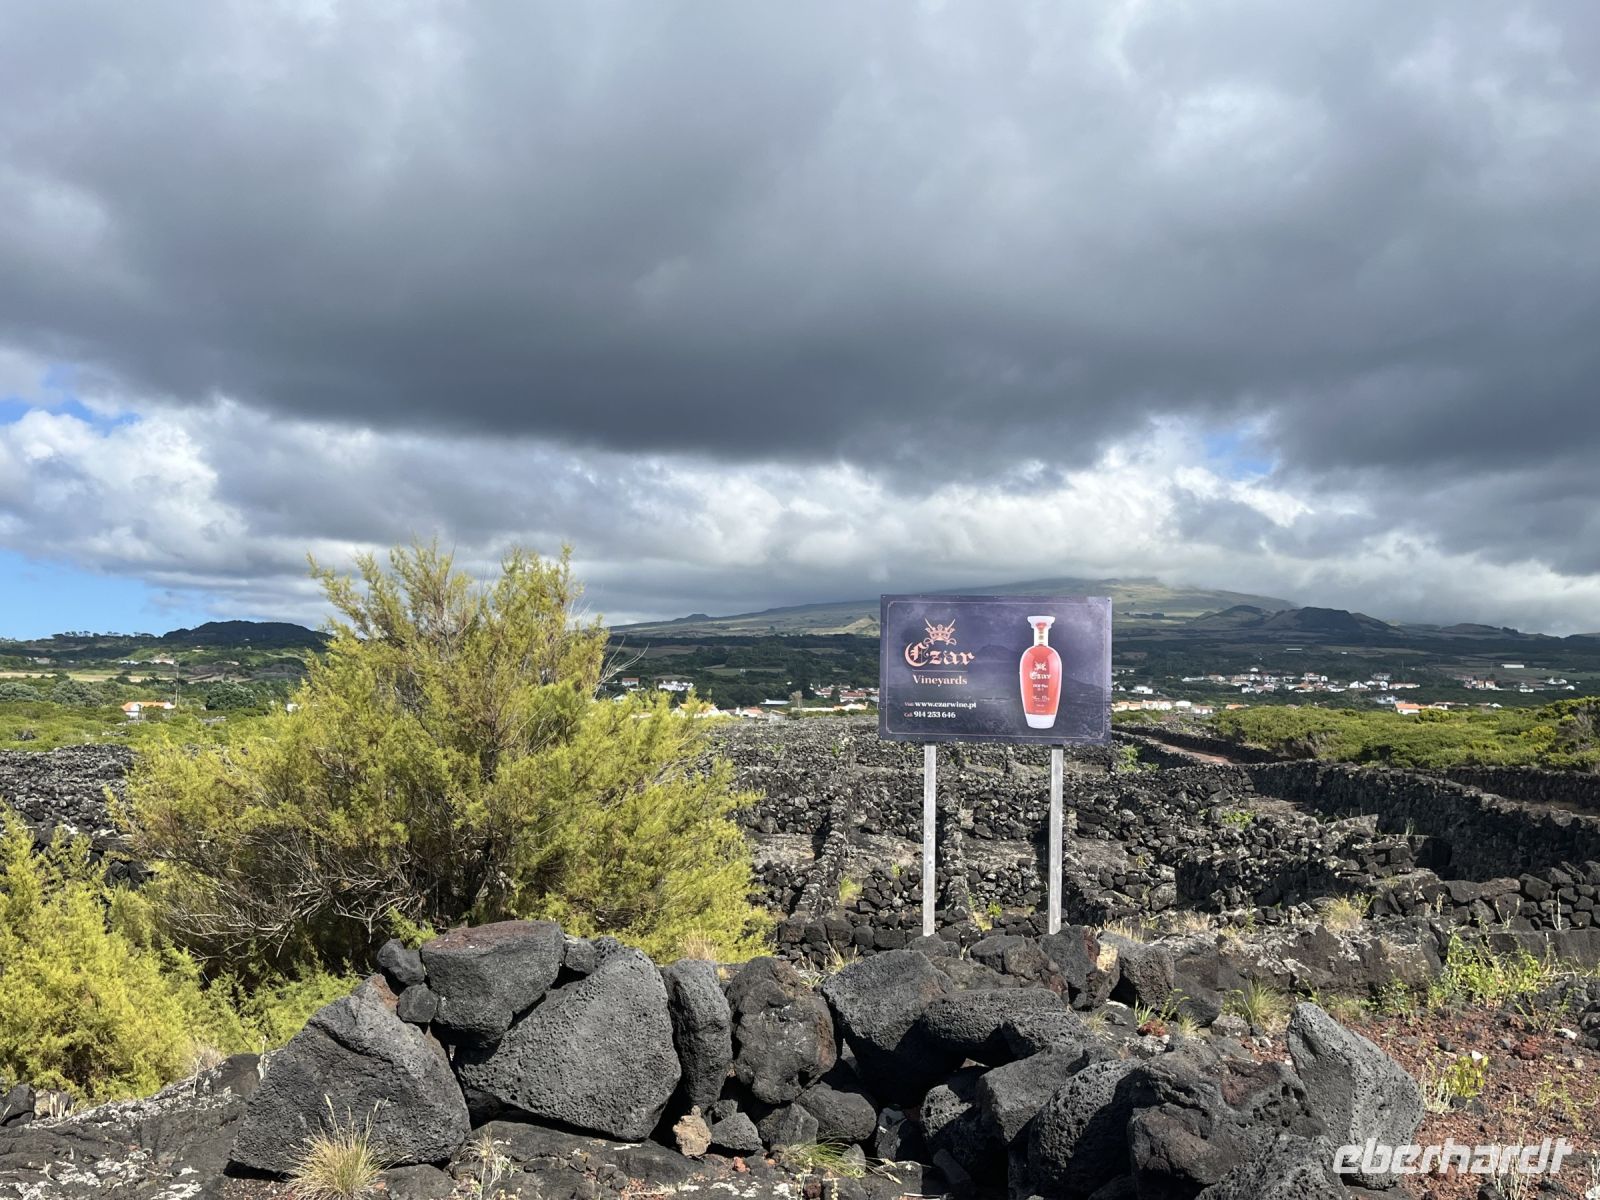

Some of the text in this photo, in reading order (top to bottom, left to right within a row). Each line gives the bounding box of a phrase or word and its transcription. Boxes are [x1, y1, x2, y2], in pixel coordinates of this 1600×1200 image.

[904, 642, 975, 667] Czar
[912, 674, 968, 687] Vineyards
[914, 701, 977, 710] www.czarwine.pt
[913, 710, 926, 718] 914
[941, 711, 956, 719] 646
